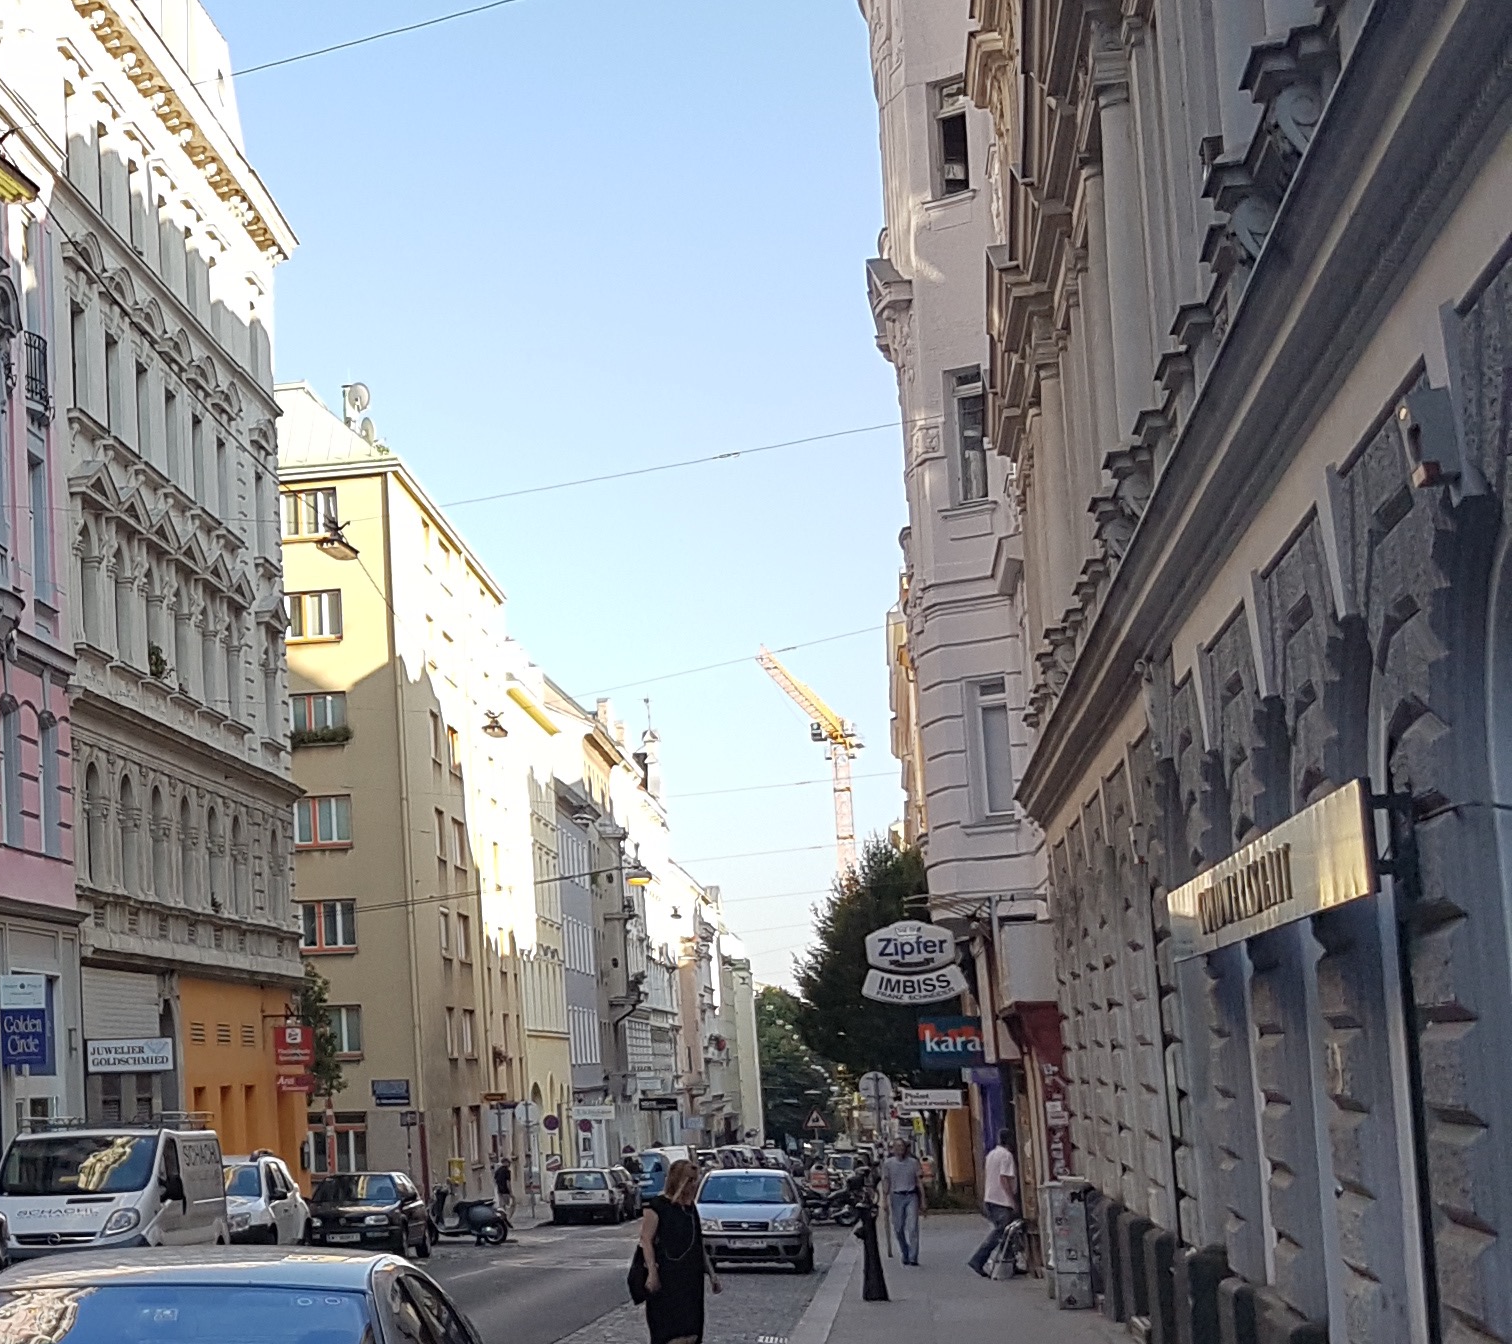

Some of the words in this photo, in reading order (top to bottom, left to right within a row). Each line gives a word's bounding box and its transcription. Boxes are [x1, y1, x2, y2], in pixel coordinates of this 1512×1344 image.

[877, 936, 947, 960] Zipfer
[878, 973, 951, 994] IMBISS
[4, 1015, 42, 1033] Golden
[8, 1035, 40, 1055] Circle
[90, 1045, 145, 1056] JUWELIER
[923, 1029, 982, 1052] kara
[91, 1055, 169, 1067] GOLDSCHMIED
